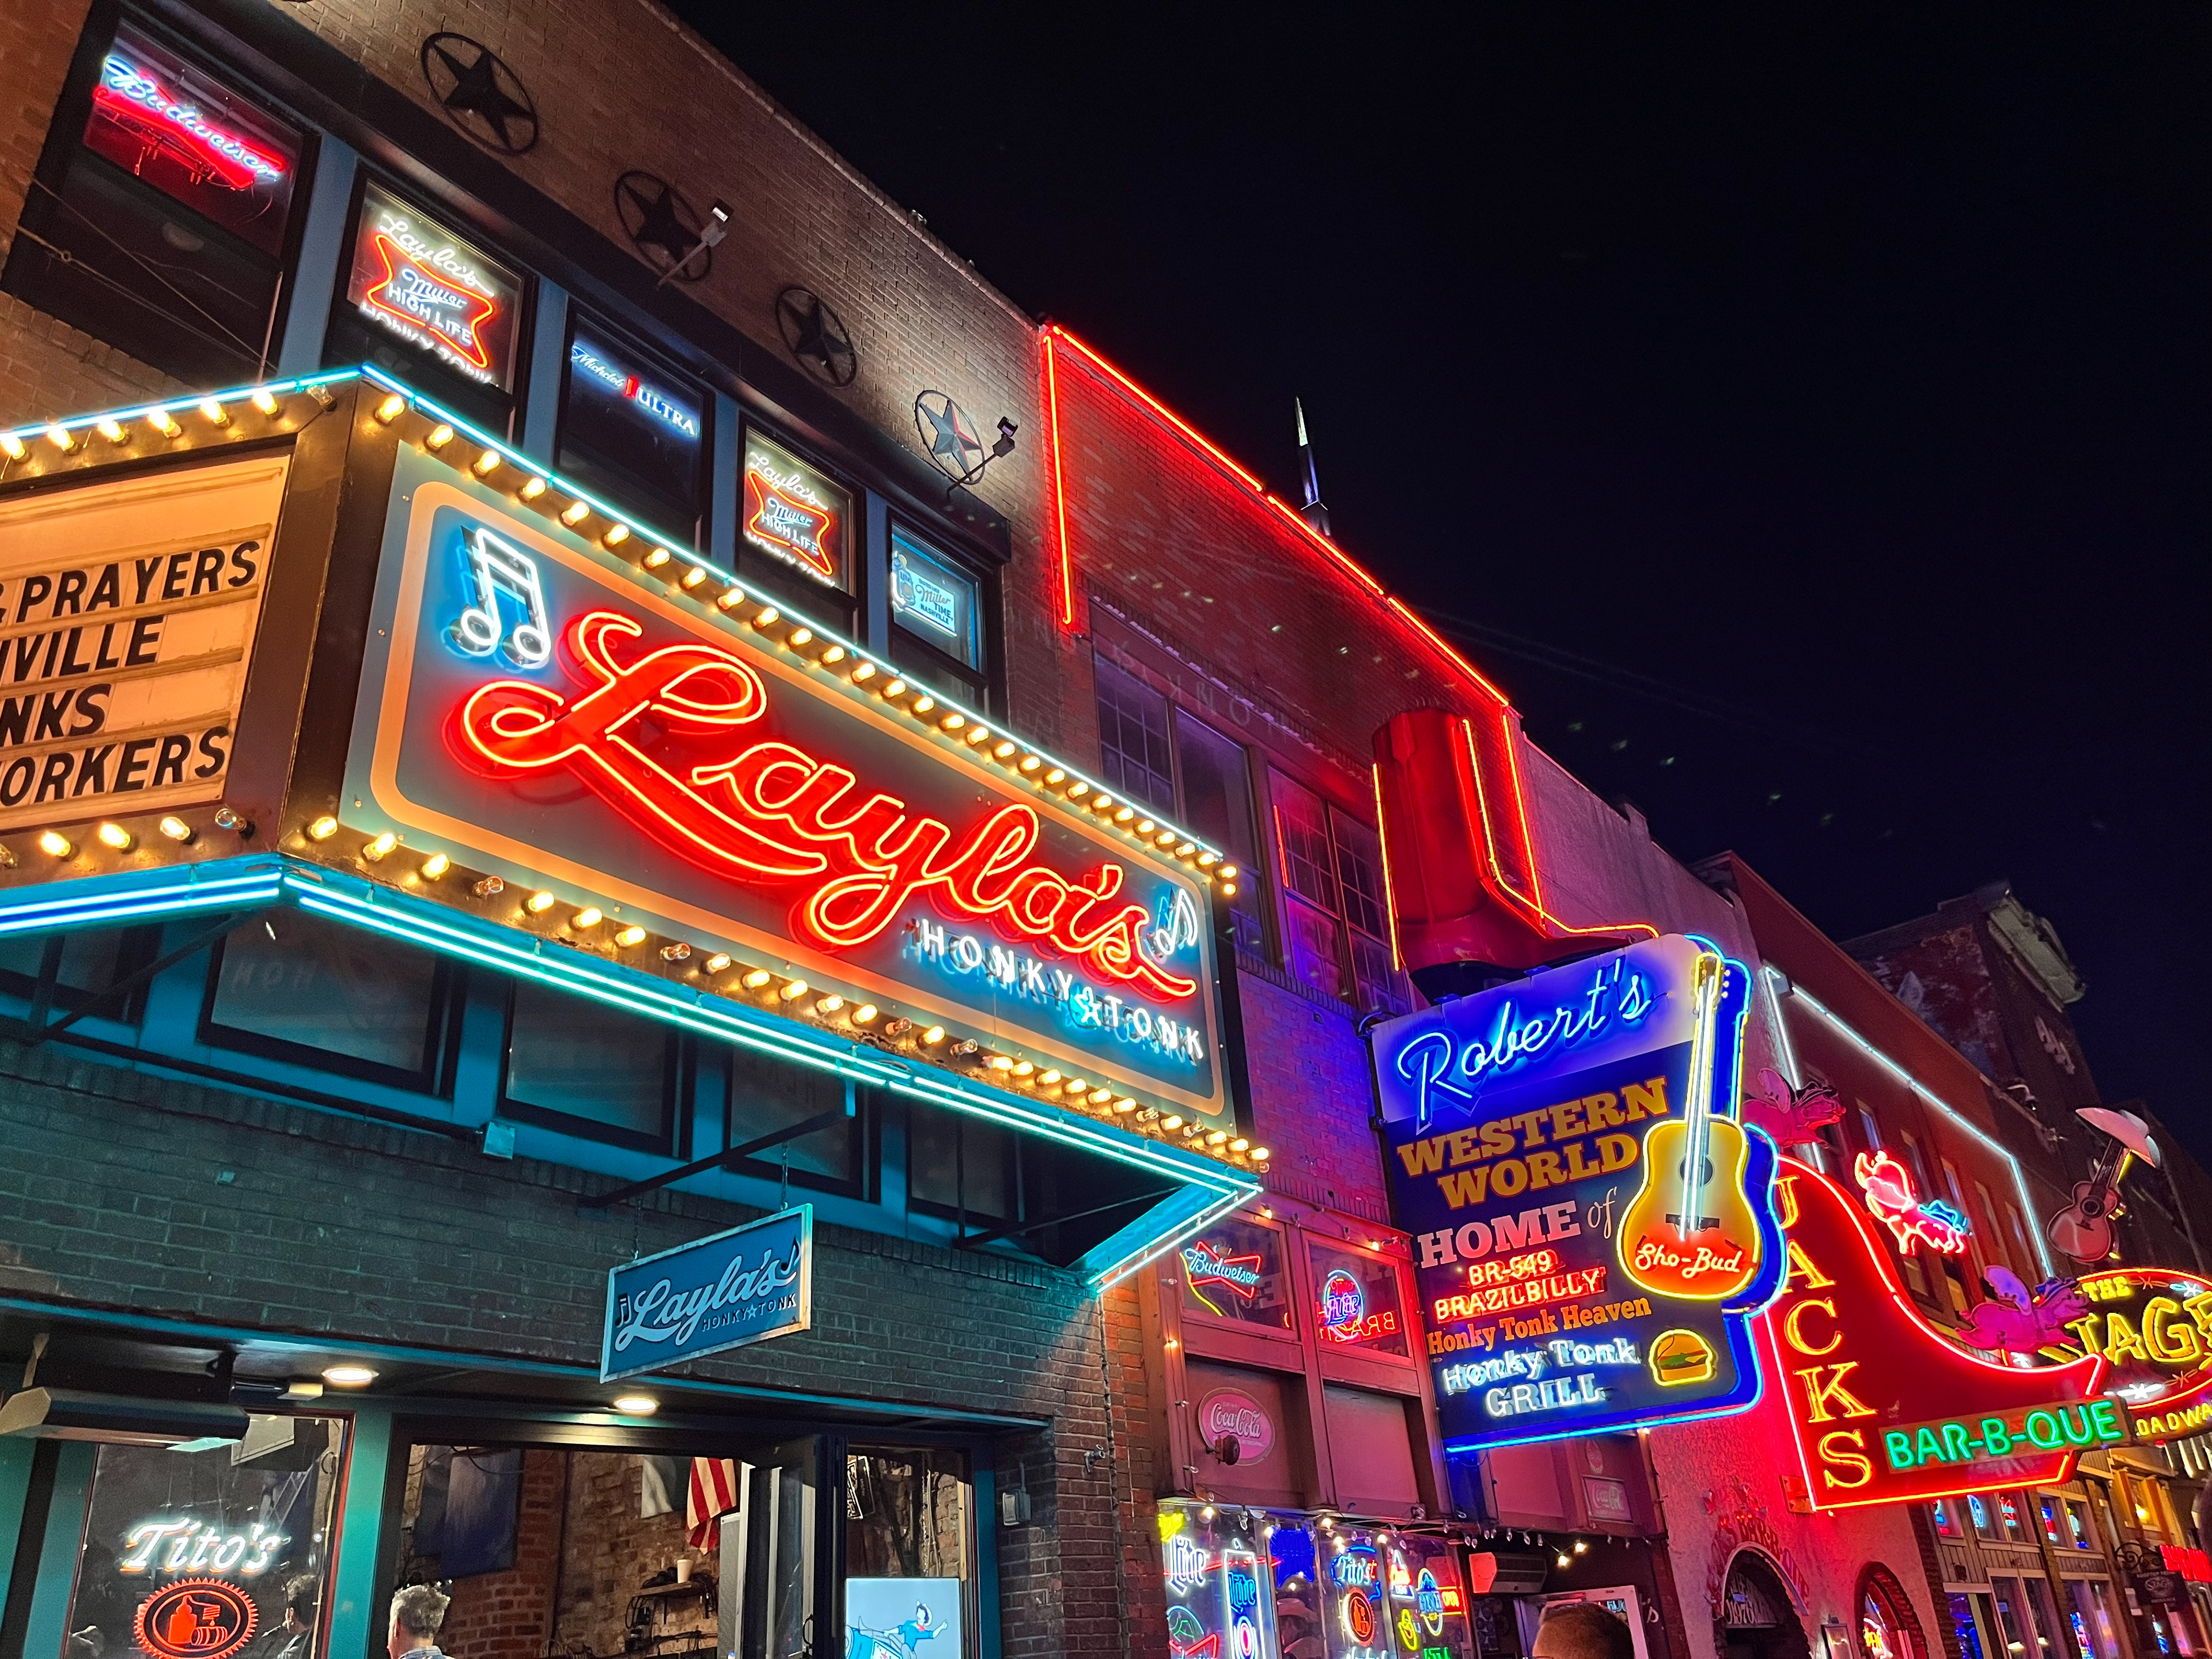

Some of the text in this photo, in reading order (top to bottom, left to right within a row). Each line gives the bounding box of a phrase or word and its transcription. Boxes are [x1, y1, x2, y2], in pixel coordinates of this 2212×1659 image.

[105, 56, 279, 181] Budweiser
[378, 212, 495, 297] Layla's
[388, 282, 472, 346] HIGH LIFE
[402, 268, 468, 309] Miller
[571, 344, 695, 435] Michelob ULTRA
[749, 452, 828, 510] Layla's
[761, 513, 819, 555] HIGH LIFE
[767, 498, 813, 527] Miller
[16, 541, 260, 623] PRAYERS
[915, 584, 951, 604] Miller
[0, 727, 229, 806] ORKERS
[462, 609, 1198, 998] Layla's
[923, 919, 1204, 1060] HONKY TONK
[1396, 959, 1651, 1123] Robert's
[1396, 1075, 1670, 1179] WESTERN
[1438, 1132, 1640, 1210] WORLD
[1418, 1187, 1616, 1268] HOME of
[1184, 1248, 1260, 1285] Budweiser
[1469, 1251, 1554, 1287] BR-549
[1635, 1243, 1744, 1279] Sho-Bud
[2082, 1276, 2131, 1302] THE
[615, 1249, 797, 1351] Layla's
[702, 1293, 797, 1332] HONKY TONK
[1435, 1269, 1602, 1321] BRAZILBILLY
[1427, 1297, 1652, 1354] Honky Tonk Heaven
[1444, 1337, 1639, 1393] Honky Tonk
[1486, 1374, 1603, 1418] GRILL
[1885, 1400, 2123, 1469] BAR-B-QUE
[120, 1516, 291, 1574] Tito's
[1168, 1534, 1210, 1596] Lite
[1337, 1552, 1371, 1585] Tito's
[1228, 1571, 1257, 1613] Lite
